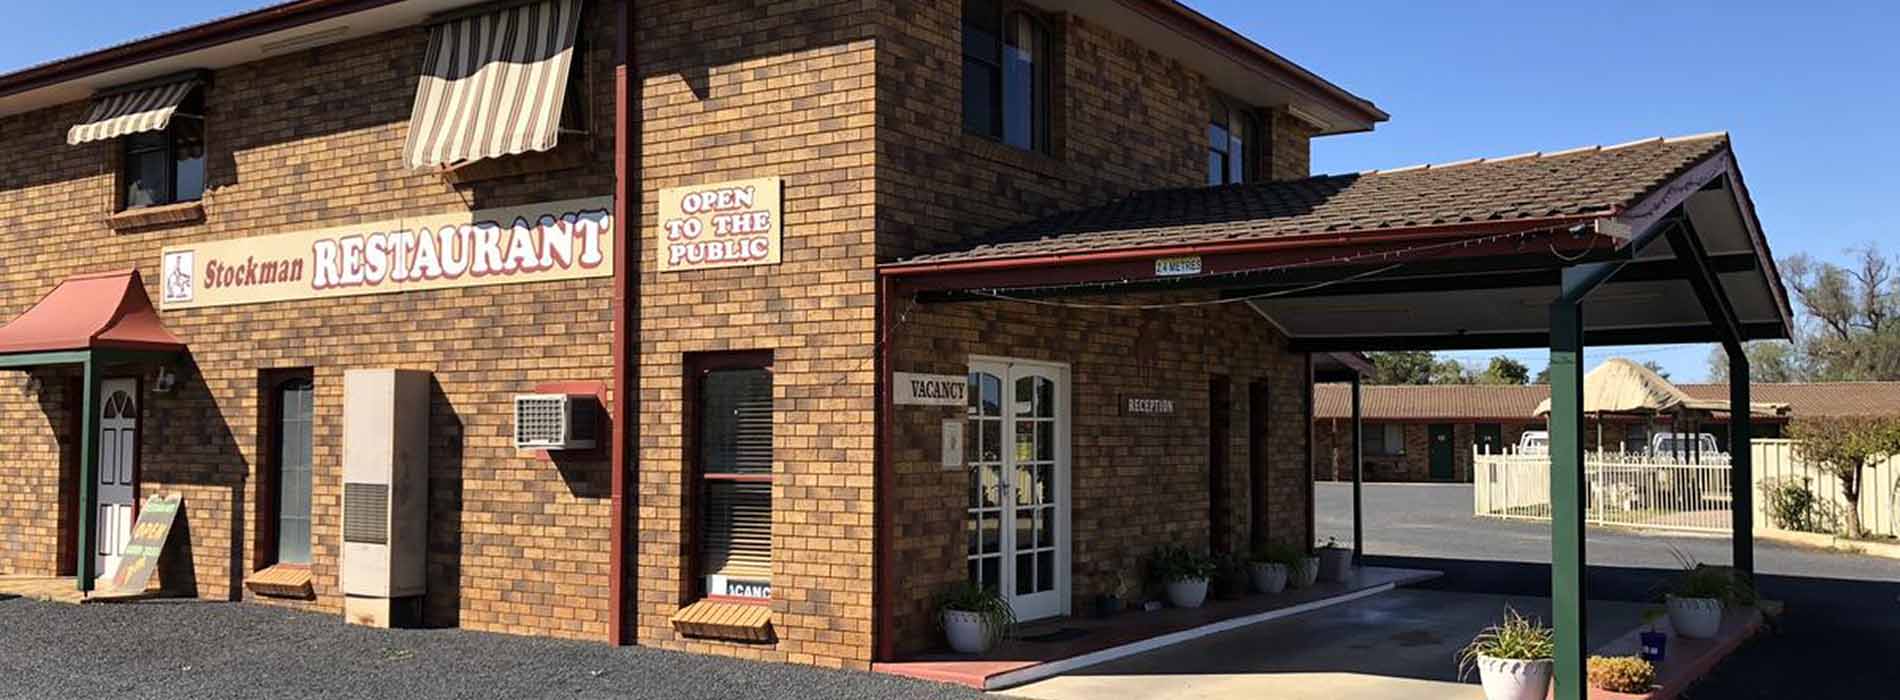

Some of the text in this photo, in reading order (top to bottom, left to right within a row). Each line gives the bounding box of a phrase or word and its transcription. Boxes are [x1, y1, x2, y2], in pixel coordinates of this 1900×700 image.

[682, 185, 755, 214] OPEN
[665, 210, 772, 241] TO THE
[203, 208, 610, 290] Stockman RESTAURANT
[668, 235, 769, 266] PUBLIC
[1169, 257, 1201, 272] METRES
[911, 379, 967, 400] VACANCY
[1127, 397, 1174, 414] RECEPTION
